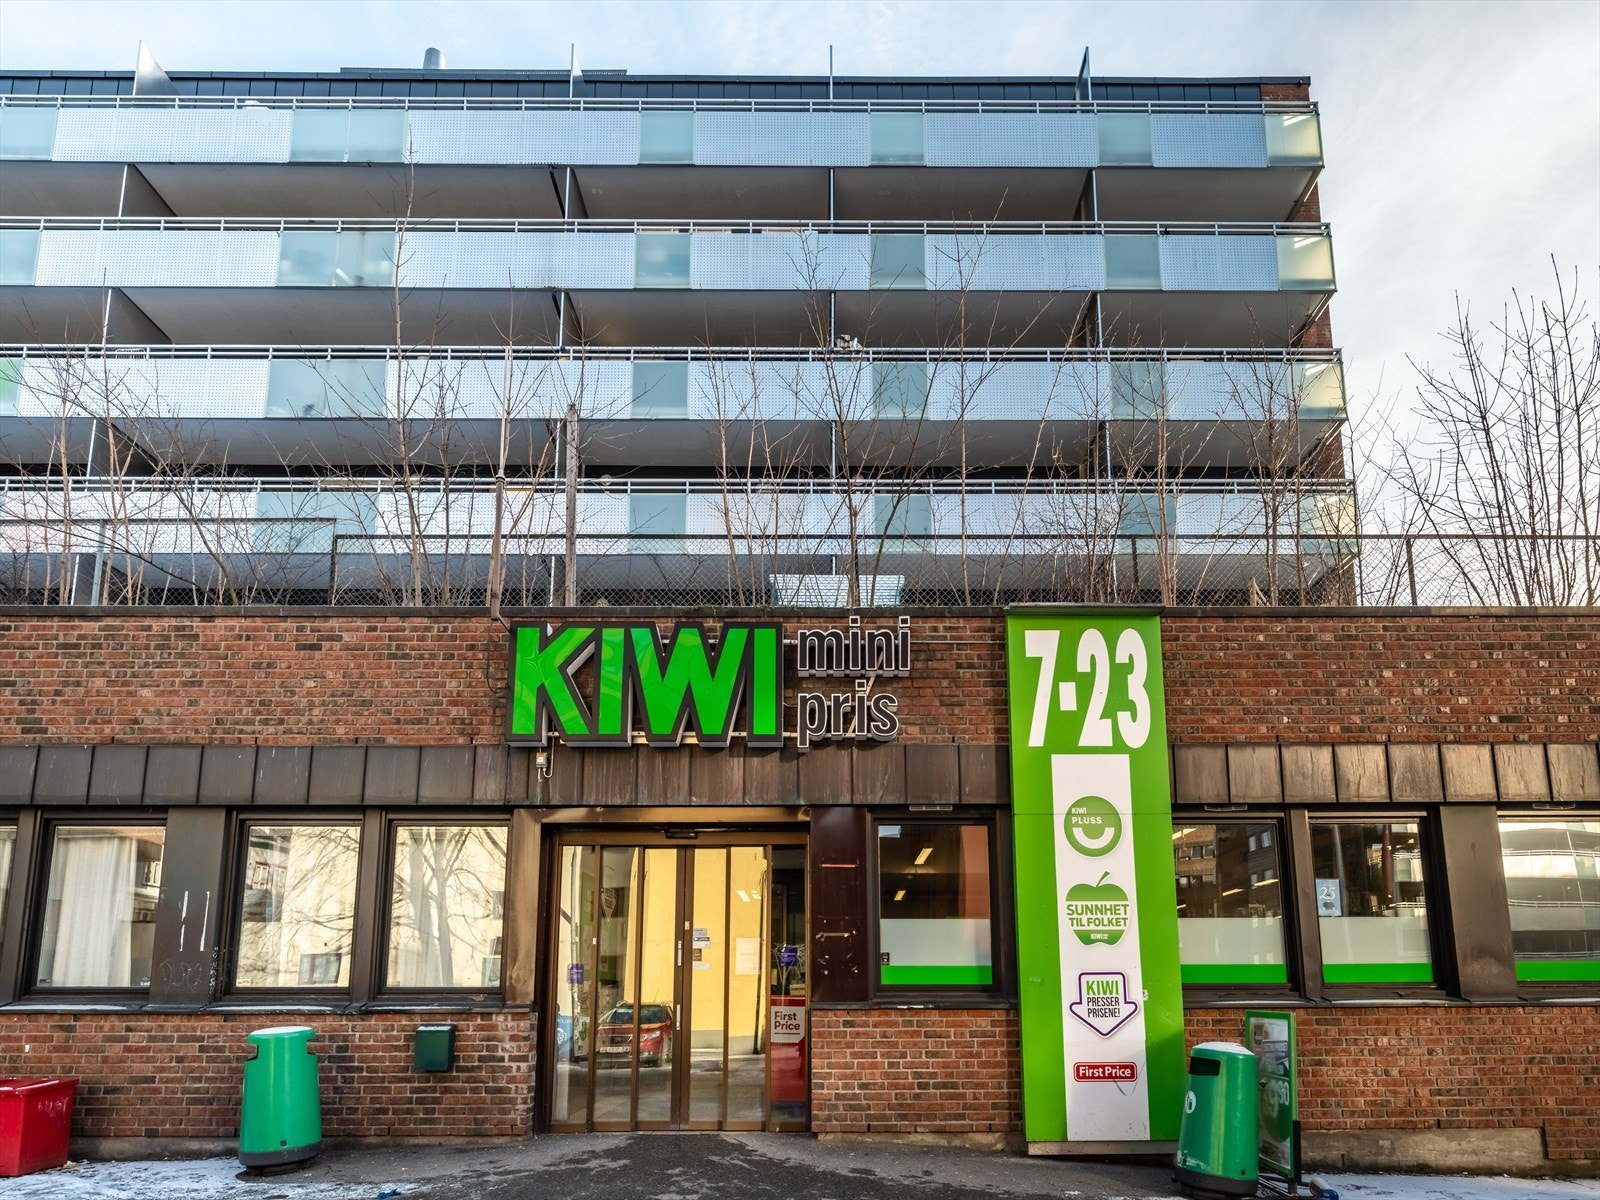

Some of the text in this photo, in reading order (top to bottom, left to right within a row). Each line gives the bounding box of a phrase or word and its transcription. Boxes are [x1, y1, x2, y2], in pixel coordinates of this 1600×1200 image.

[798, 615, 911, 673] mini
[509, 622, 783, 746] KIWI
[1024, 628, 1151, 749] 7-23
[798, 679, 899, 748] pris
[1071, 807, 1087, 815] KIWI
[1072, 816, 1102, 825] PLUSS
[1319, 886, 1337, 900] 25
[1066, 903, 1130, 916] SUNNHET
[1068, 917, 1129, 927] TIL FOLKET
[1085, 980, 1119, 996] KIWI
[1087, 996, 1120, 1007] PRESSER
[774, 1011, 797, 1021] First
[1087, 1007, 1121, 1018] PRISENE!
[774, 1021, 801, 1031] Price
[1079, 1066, 1132, 1077] First Price
